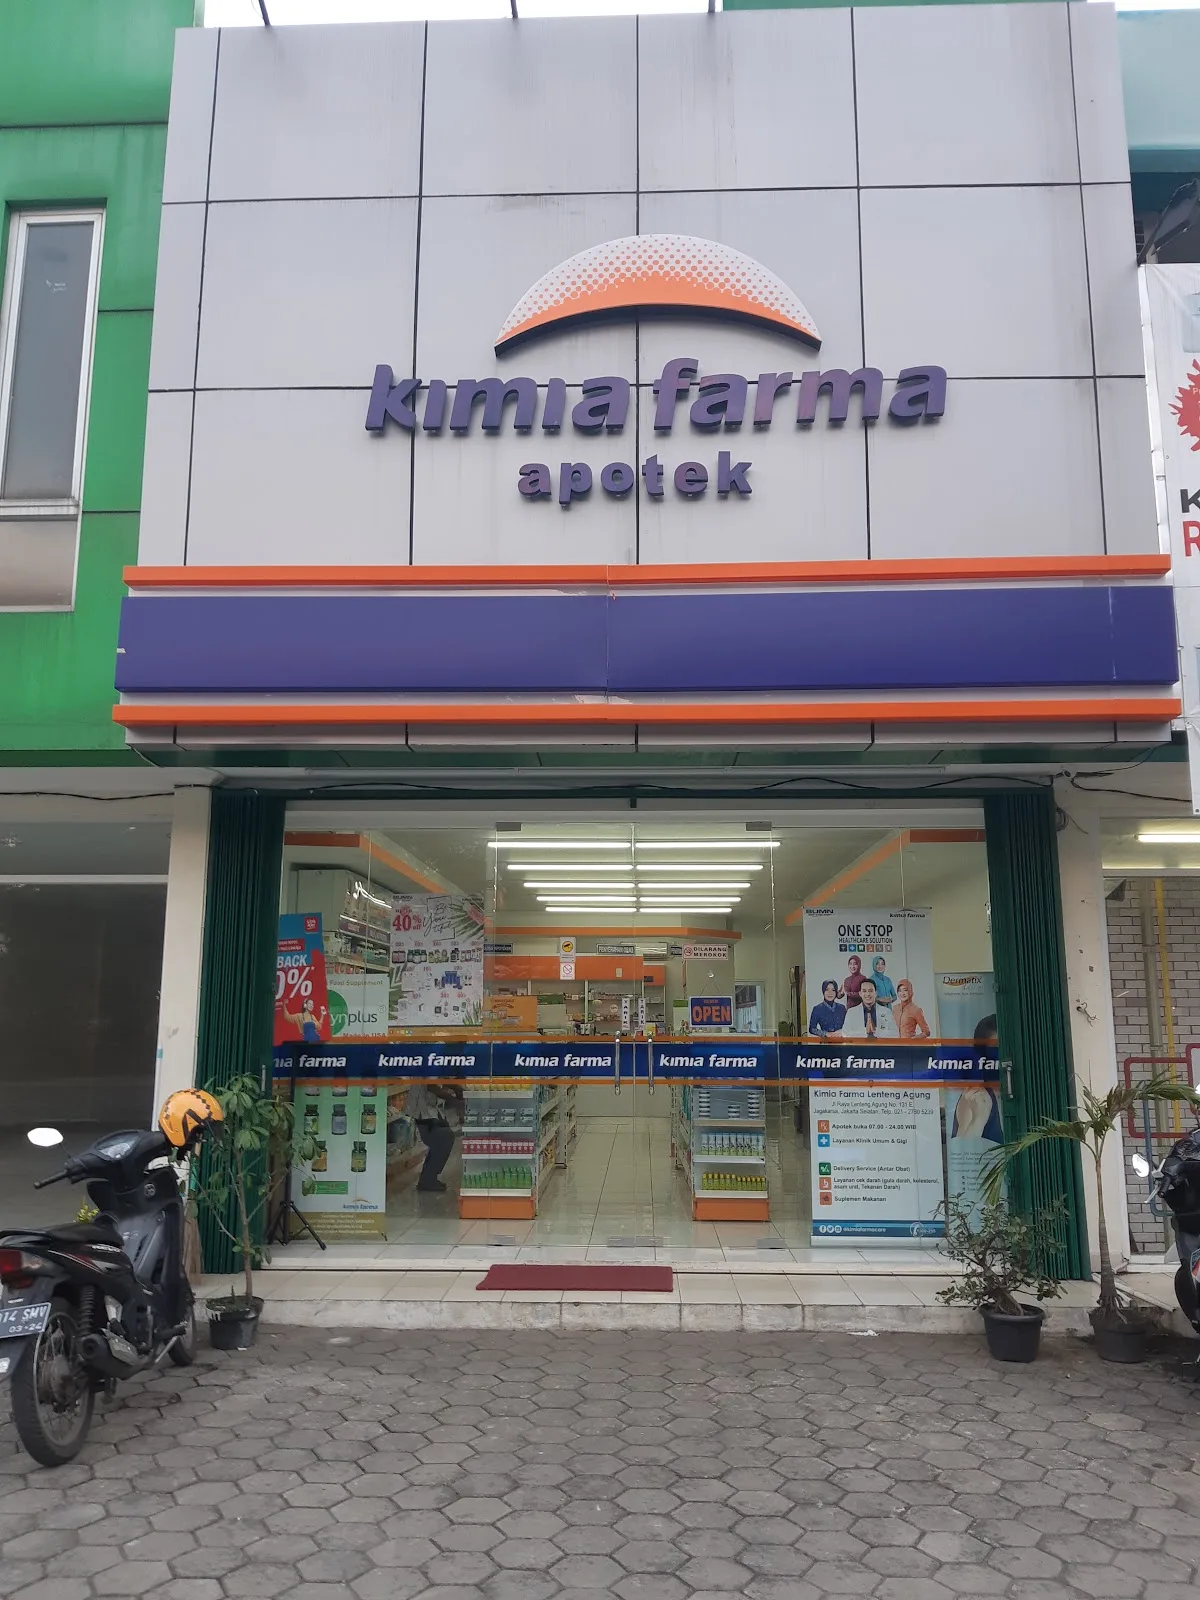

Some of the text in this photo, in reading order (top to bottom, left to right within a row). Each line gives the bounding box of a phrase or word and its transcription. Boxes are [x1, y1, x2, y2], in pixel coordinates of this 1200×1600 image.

[365, 358, 949, 432] kimia farma
[518, 451, 753, 505] apotek
[838, 925, 893, 937] ONE STOP
[276, 954, 308, 968] BACK
[942, 976, 982, 984] Dermatix
[692, 1005, 731, 1023] OPEN
[299, 1055, 347, 1067] farma
[378, 1053, 476, 1067] kimia farma
[514, 1054, 611, 1067] kimia farma
[659, 1053, 757, 1067] kimia farma
[796, 1055, 895, 1069] kimia farma
[928, 1057, 973, 1070] kimia
[814, 1090, 931, 1100] Kimia Farma Lenteng Agung
